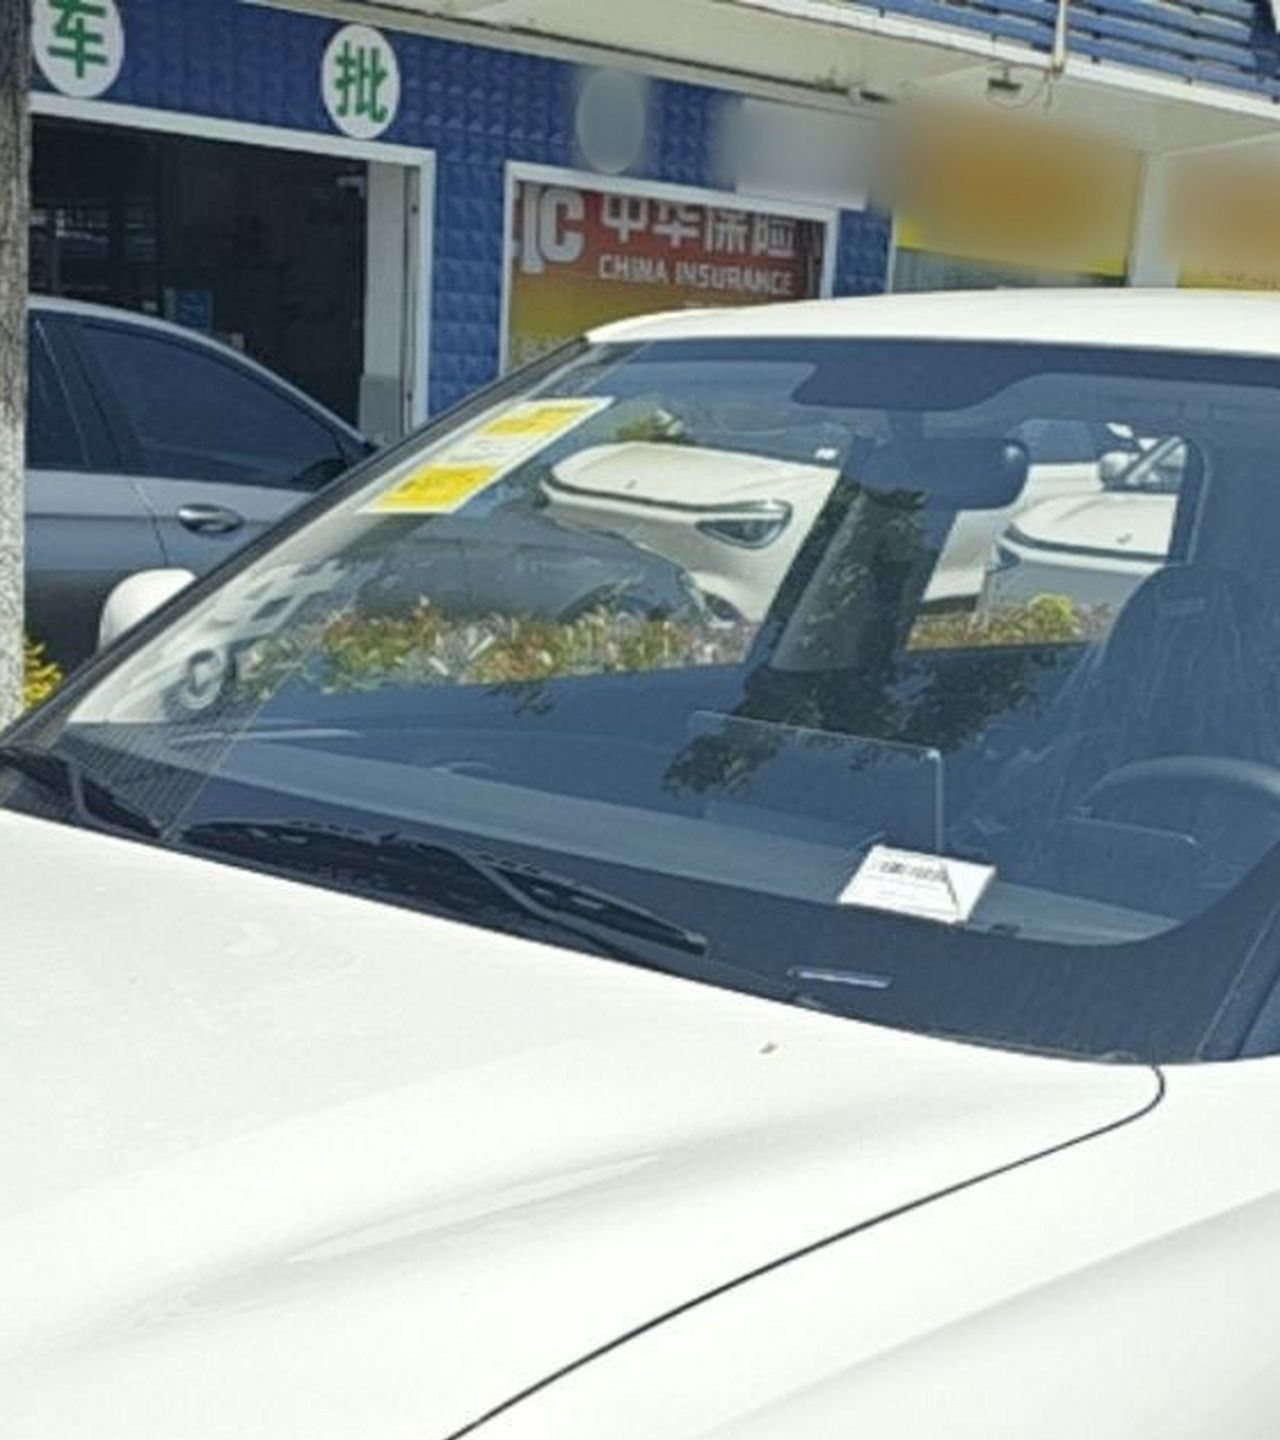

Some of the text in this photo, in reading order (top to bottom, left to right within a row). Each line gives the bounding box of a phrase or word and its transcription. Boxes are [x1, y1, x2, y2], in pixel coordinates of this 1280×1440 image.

[47, 0, 389, 123] 车 批
[599, 253, 795, 296] CHINA INSURANCE
